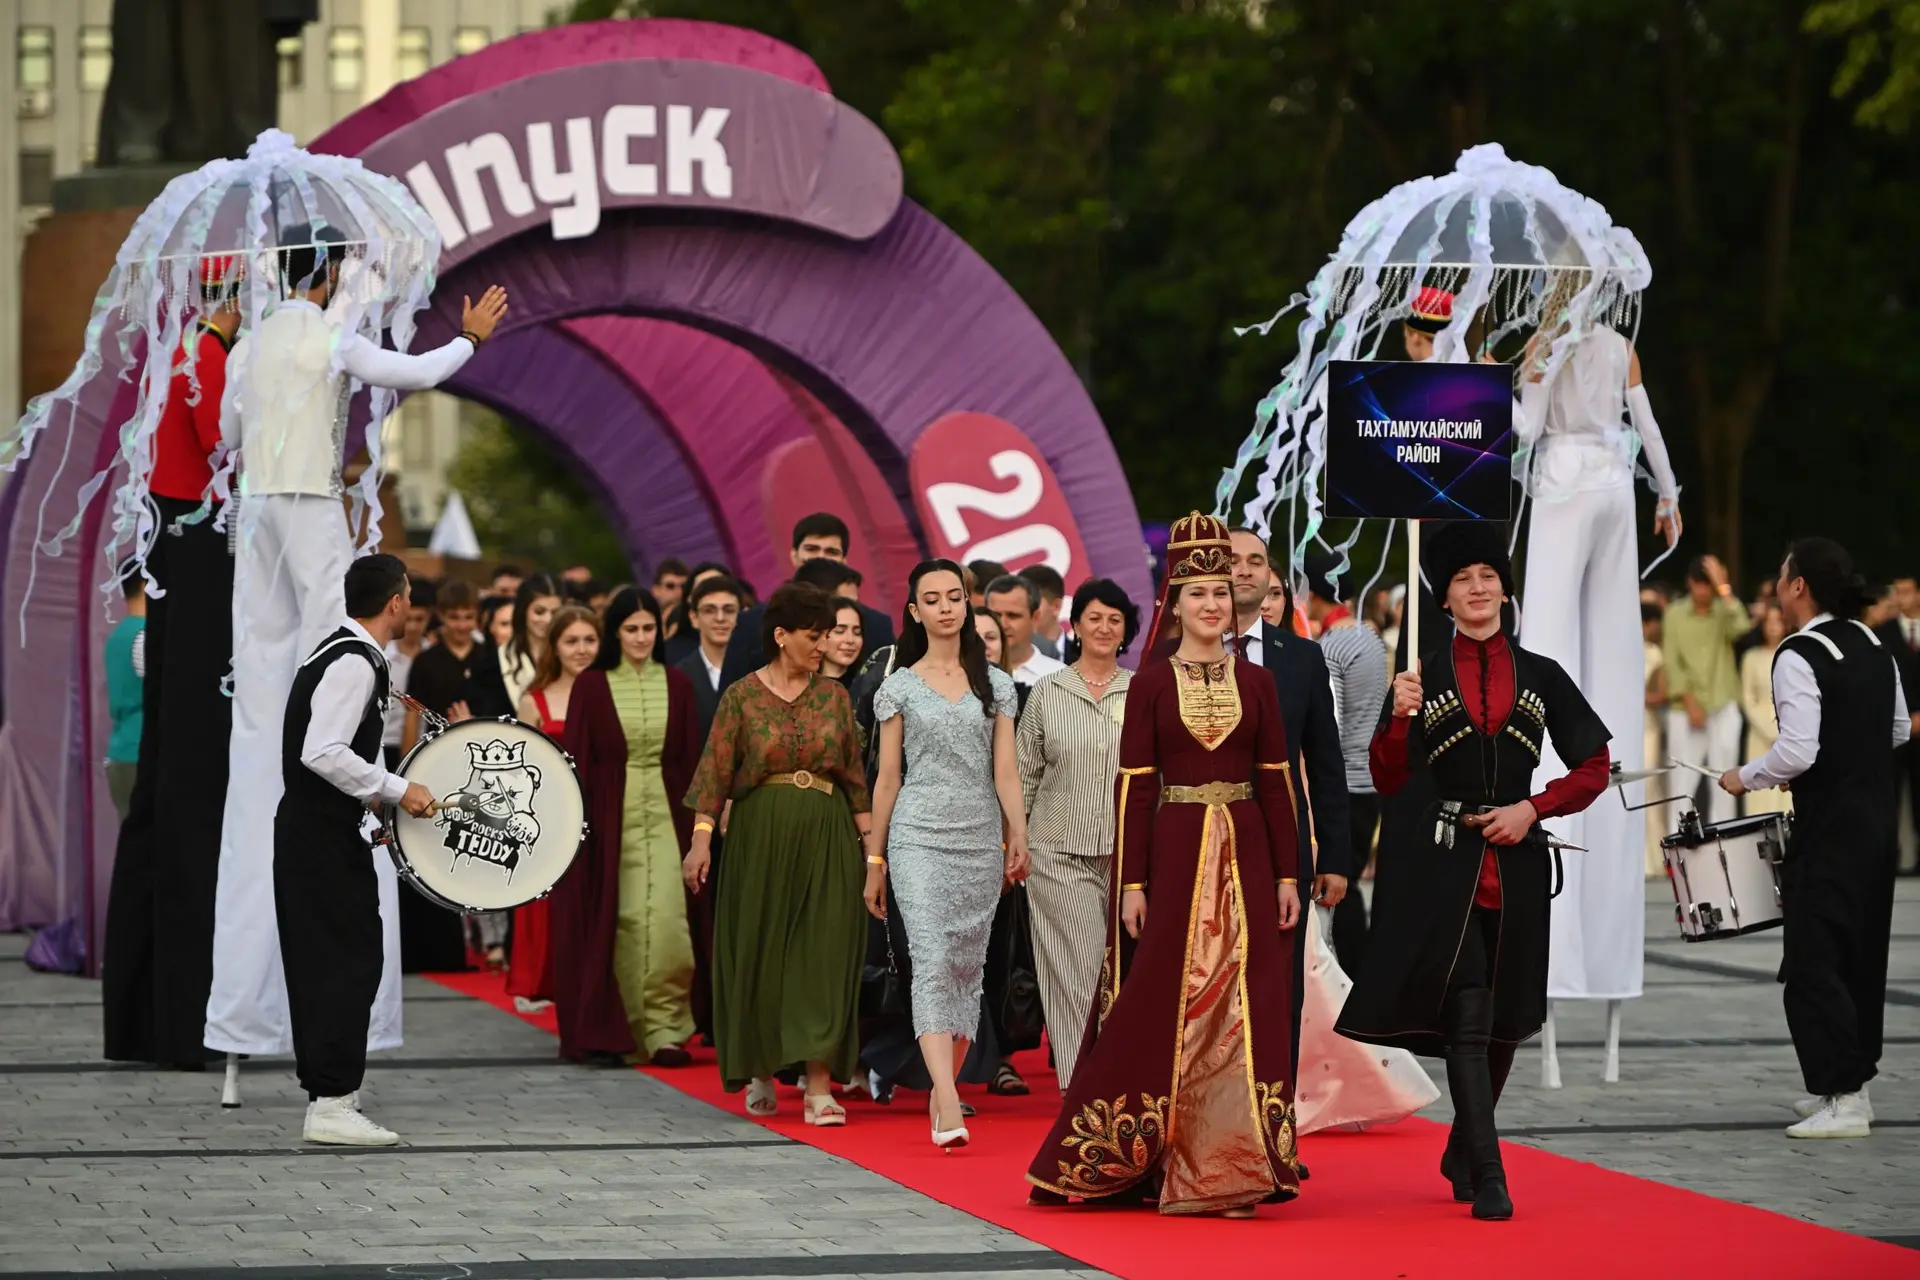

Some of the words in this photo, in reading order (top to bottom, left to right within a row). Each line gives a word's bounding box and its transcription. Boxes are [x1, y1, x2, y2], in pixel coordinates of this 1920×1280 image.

[1357, 419, 1482, 439] ТАХТАМУКАЙСКИЙ
[1397, 443, 1440, 463] РАЙОН
[470, 821, 505, 841] ROCKS
[457, 829, 514, 863] TEDDY
